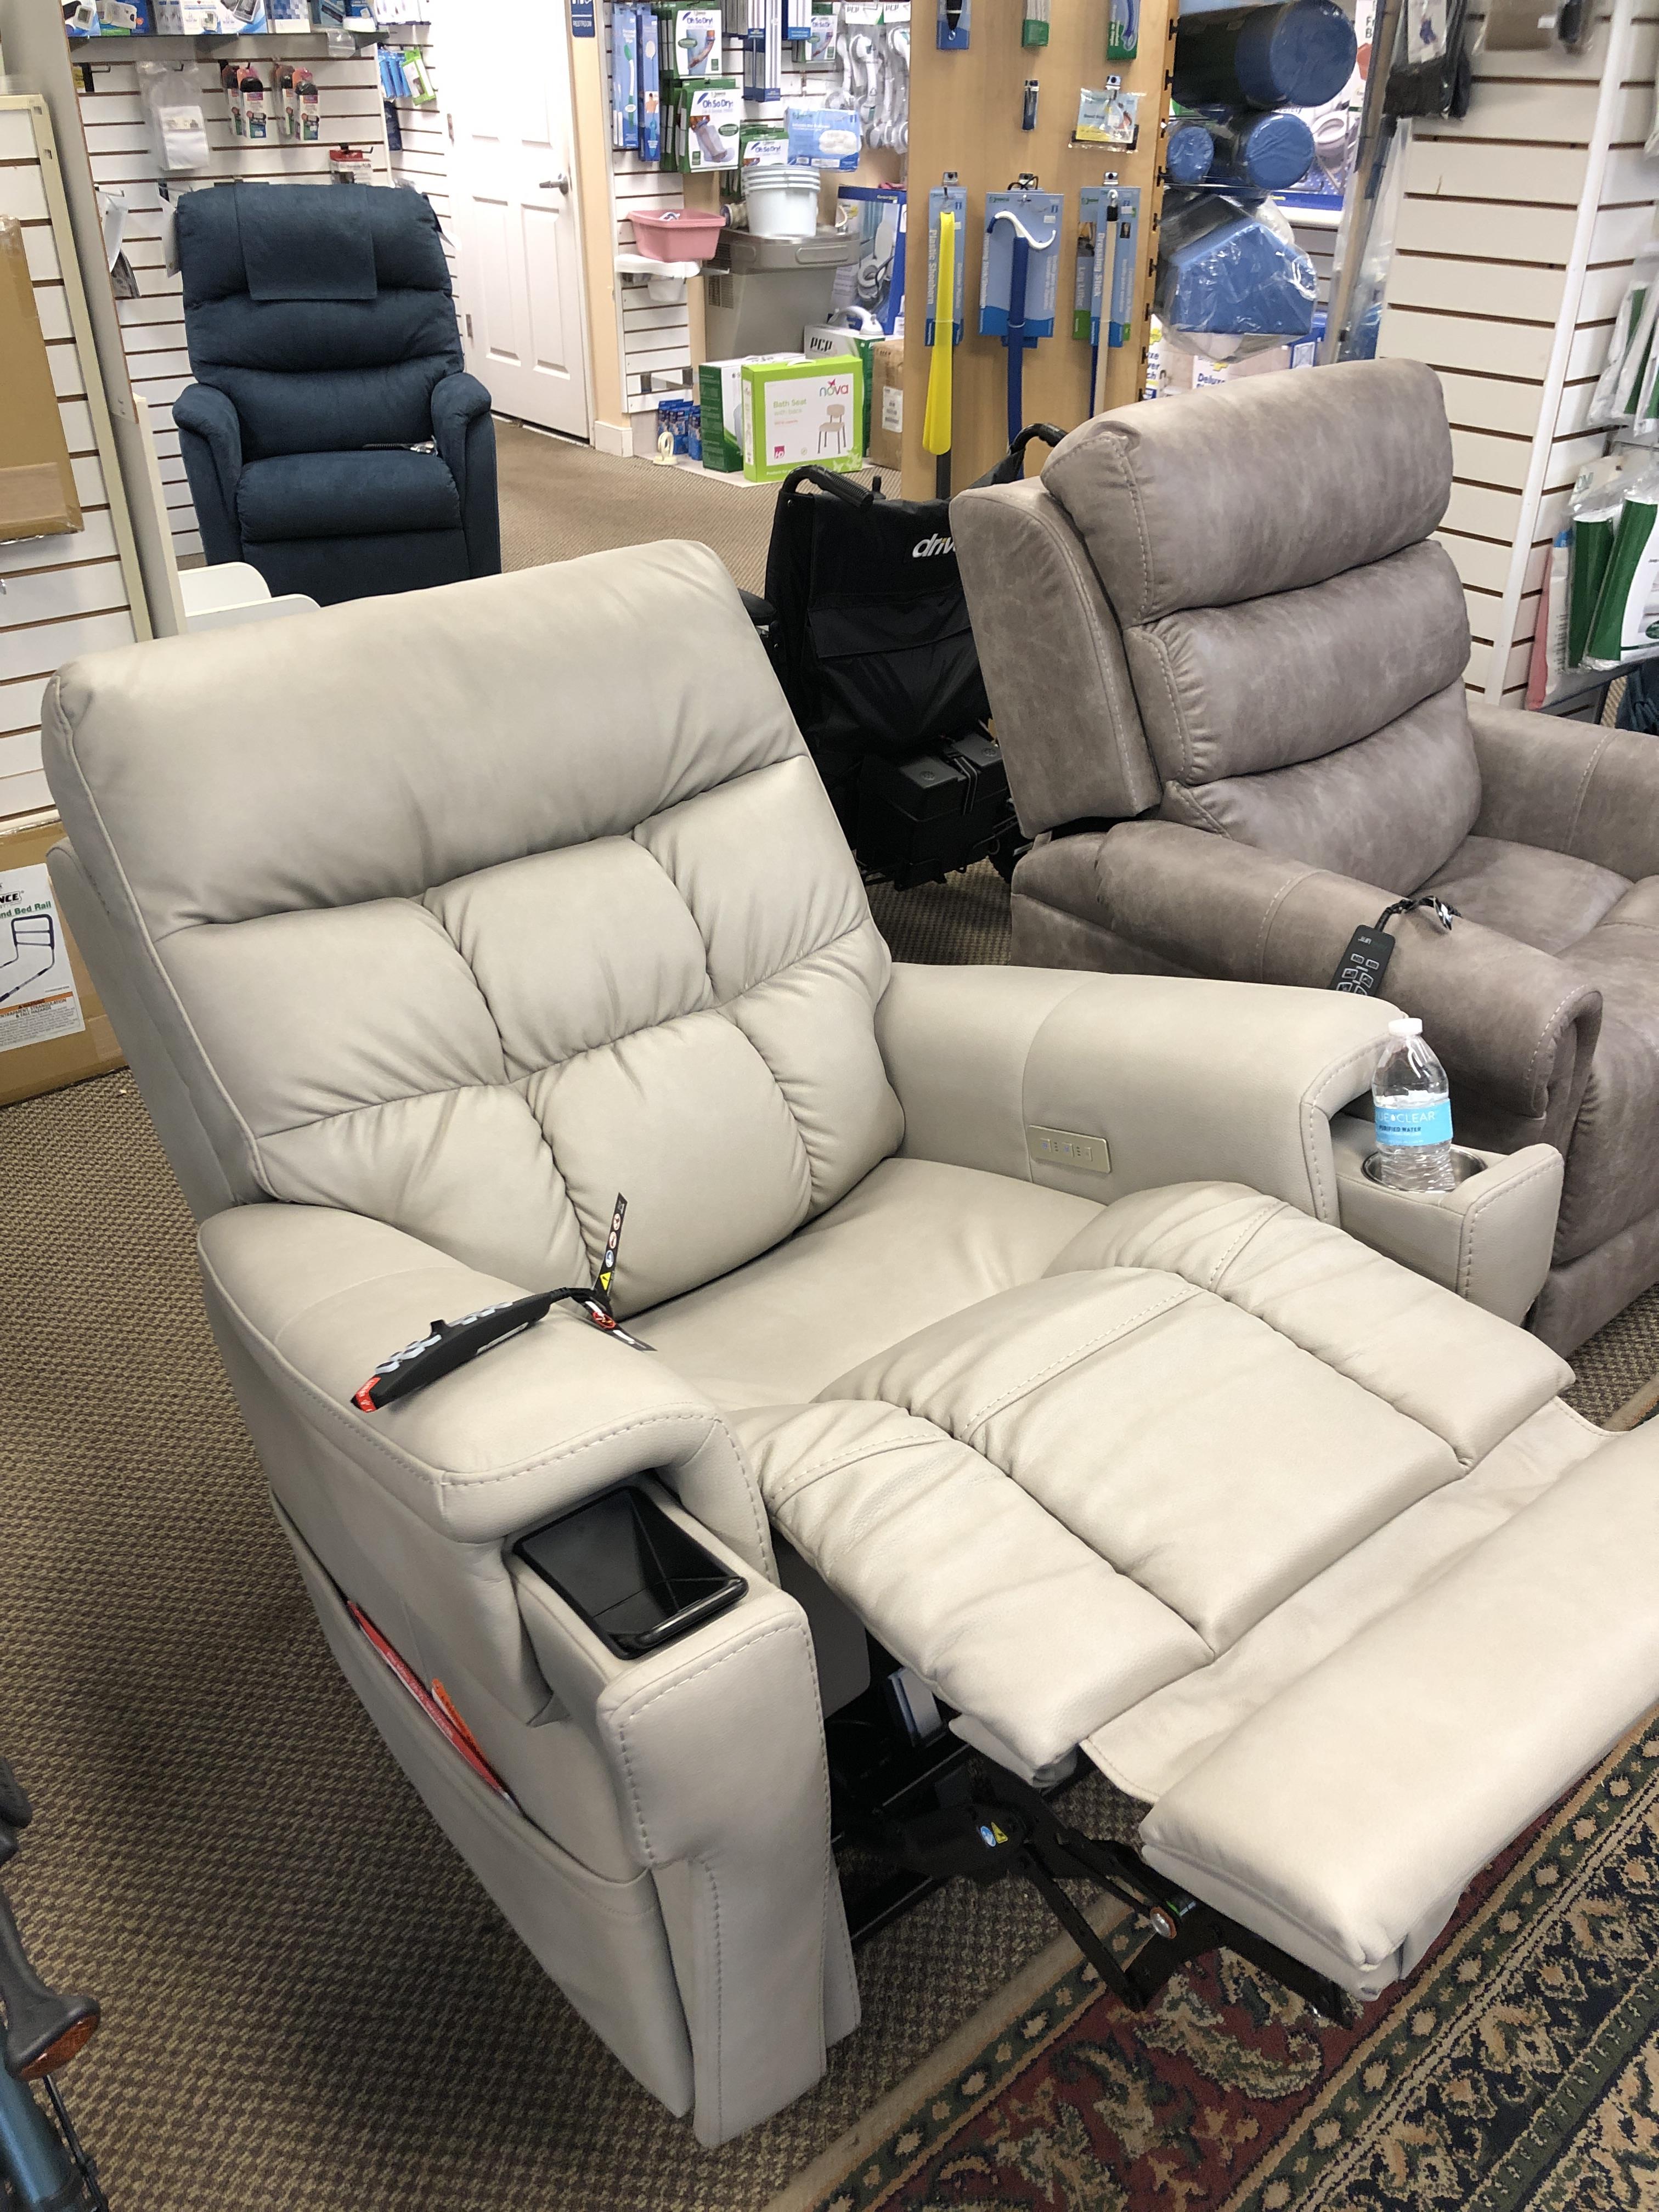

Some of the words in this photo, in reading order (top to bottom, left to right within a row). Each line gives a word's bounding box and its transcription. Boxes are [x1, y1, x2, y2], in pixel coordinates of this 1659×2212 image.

[702, 100, 712, 108] Oh
[713, 99, 720, 108] So
[929, 229, 938, 260] Plastic
[1094, 232, 1105, 272] Dressing
[927, 263, 937, 305] Shoehorn
[1093, 275, 1103, 297] Stick
[810, 337, 833, 352] PCP
[819, 384, 849, 397] nova
[912, 533, 956, 558] driv
[0, 909, 12, 918] nd
[14, 905, 32, 915] Bed
[35, 900, 52, 911] Rail
[1397, 1110, 1435, 1124] CLEAR
